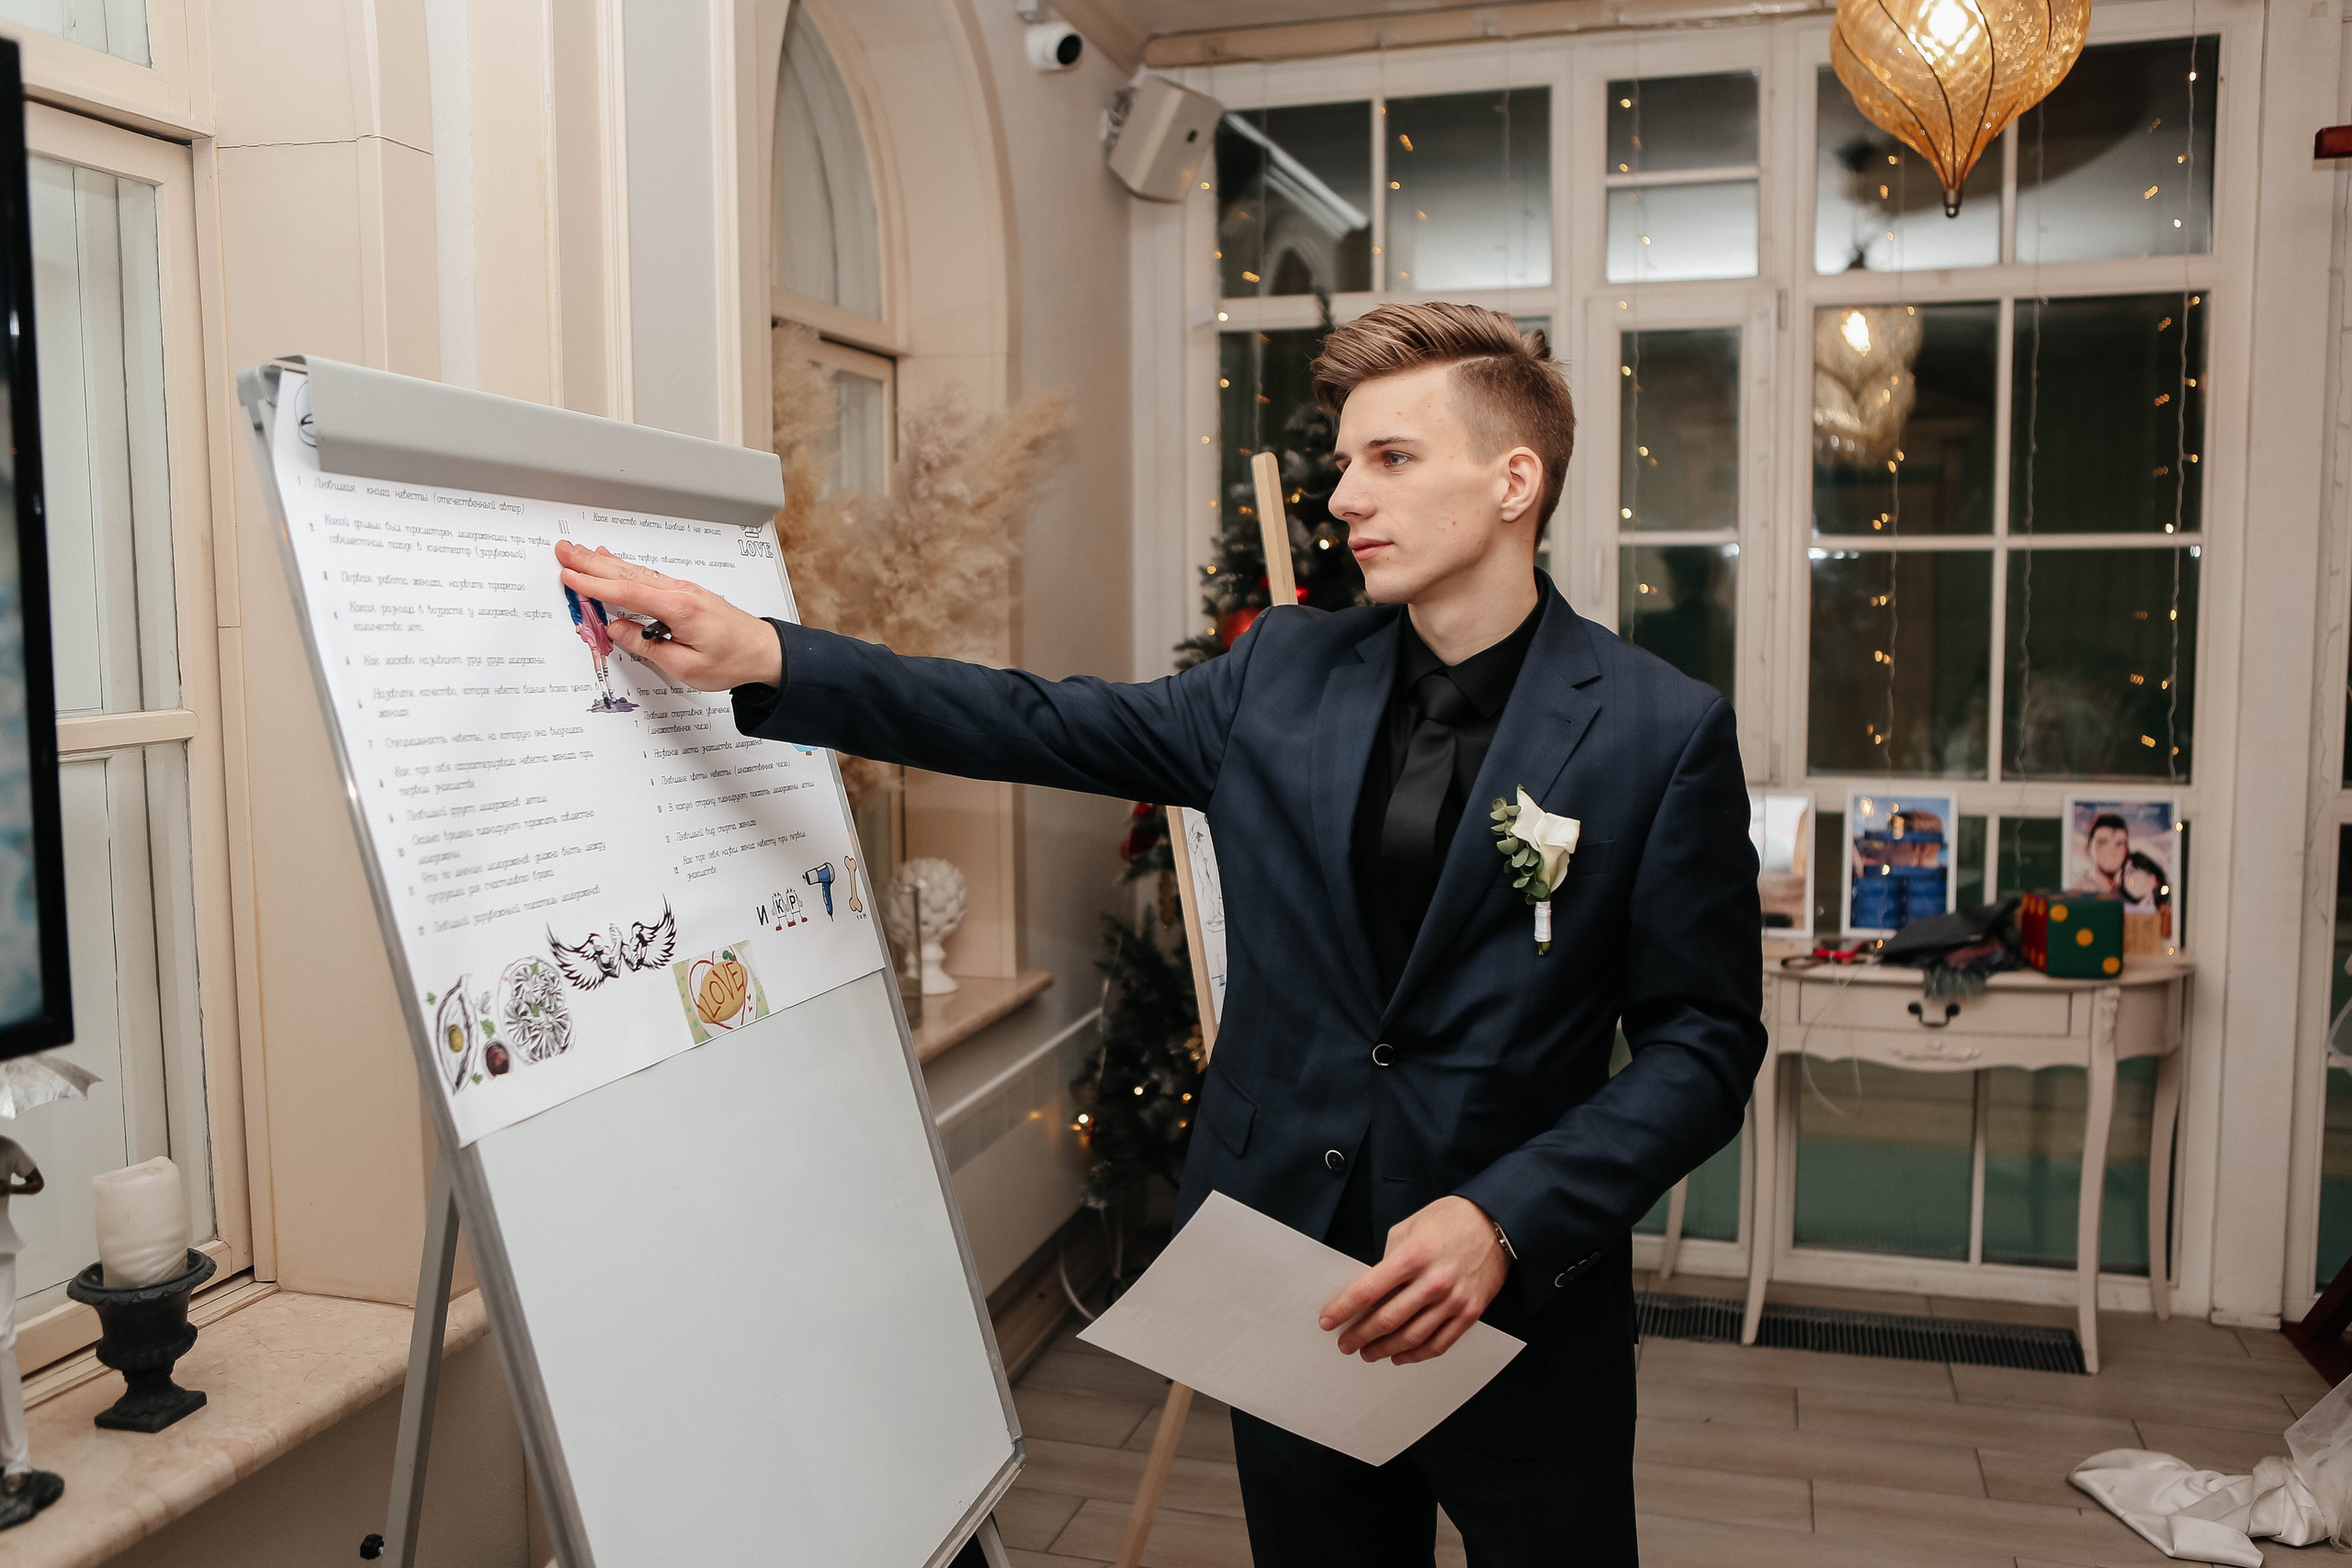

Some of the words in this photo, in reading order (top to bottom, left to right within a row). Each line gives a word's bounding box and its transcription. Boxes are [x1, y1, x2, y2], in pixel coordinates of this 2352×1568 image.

[314, 477, 356, 492] Любимая
[367, 486, 390, 497] книга
[395, 489, 429, 502] невесты
[433, 491, 496, 511] (отечественный
[499, 501, 525, 515] автор)
[593, 512, 609, 524] Какое
[611, 516, 637, 526] качество
[639, 518, 662, 530] невесты
[324, 513, 350, 526] Какой
[354, 519, 381, 530] фильм
[386, 521, 401, 532] был
[405, 525, 454, 538] просмотрен
[511, 536, 526, 545] при
[528, 536, 551, 546] первом
[425, 544, 472, 558] кинотеатр
[738, 538, 774, 558] LOVE
[378, 574, 409, 586] работа
[637, 687, 650, 696] Что
[644, 710, 669, 720] Любимое
[671, 708, 704, 719] спортивное
[694, 720, 712, 731] число)
[653, 748, 679, 759] Название
[662, 775, 688, 785] Любимые
[689, 773, 708, 782] цветы
[710, 769, 732, 778] невесты
[668, 803, 673, 812] В
[695, 798, 717, 808] страну
[676, 829, 704, 841] Любимый
[705, 827, 716, 837] вид
[717, 823, 737, 833] спорта
[695, 854, 707, 863] про
[707, 850, 720, 860] себя
[757, 839, 777, 849] невесту
[777, 835, 788, 845] при
[700, 962, 744, 1019] LOVE
